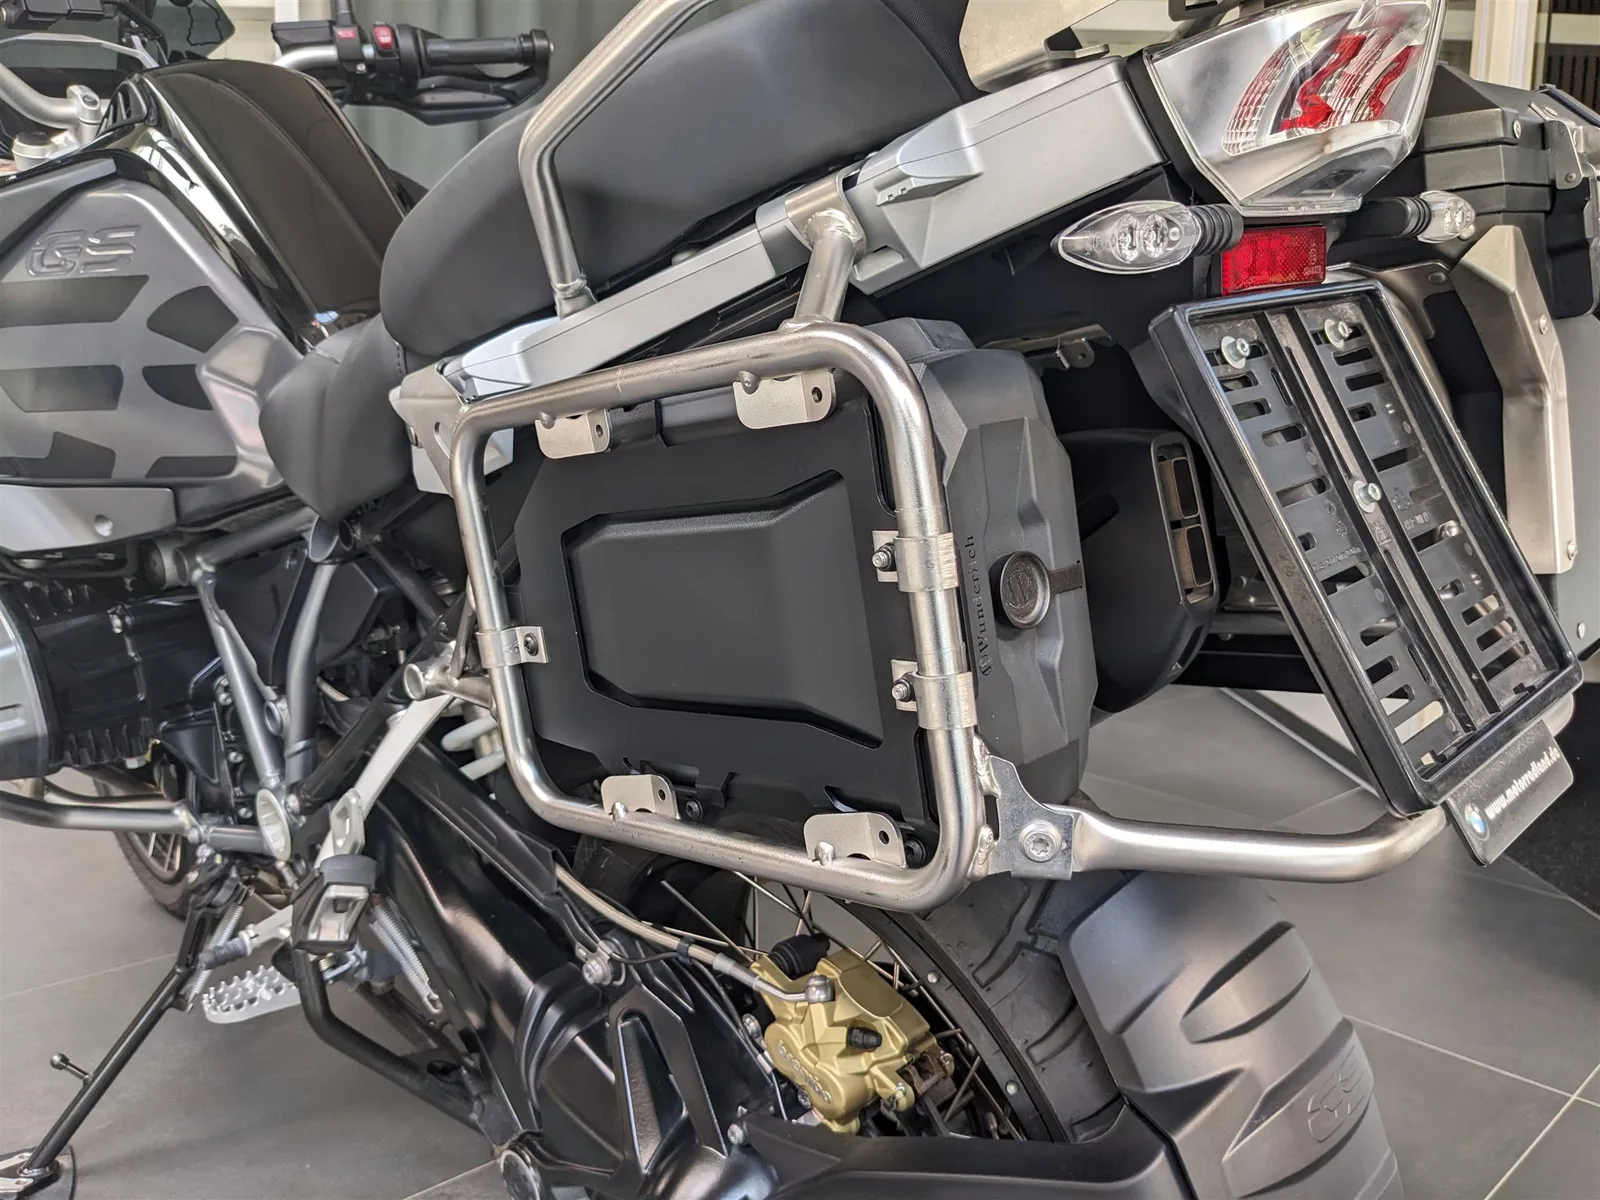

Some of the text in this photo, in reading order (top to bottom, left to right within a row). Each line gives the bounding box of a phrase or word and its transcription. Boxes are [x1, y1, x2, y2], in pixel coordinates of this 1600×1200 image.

[26, 225, 141, 277] GS
[964, 535, 989, 658] Wunderlich
[1484, 746, 1560, 820] www.motorradland.de
